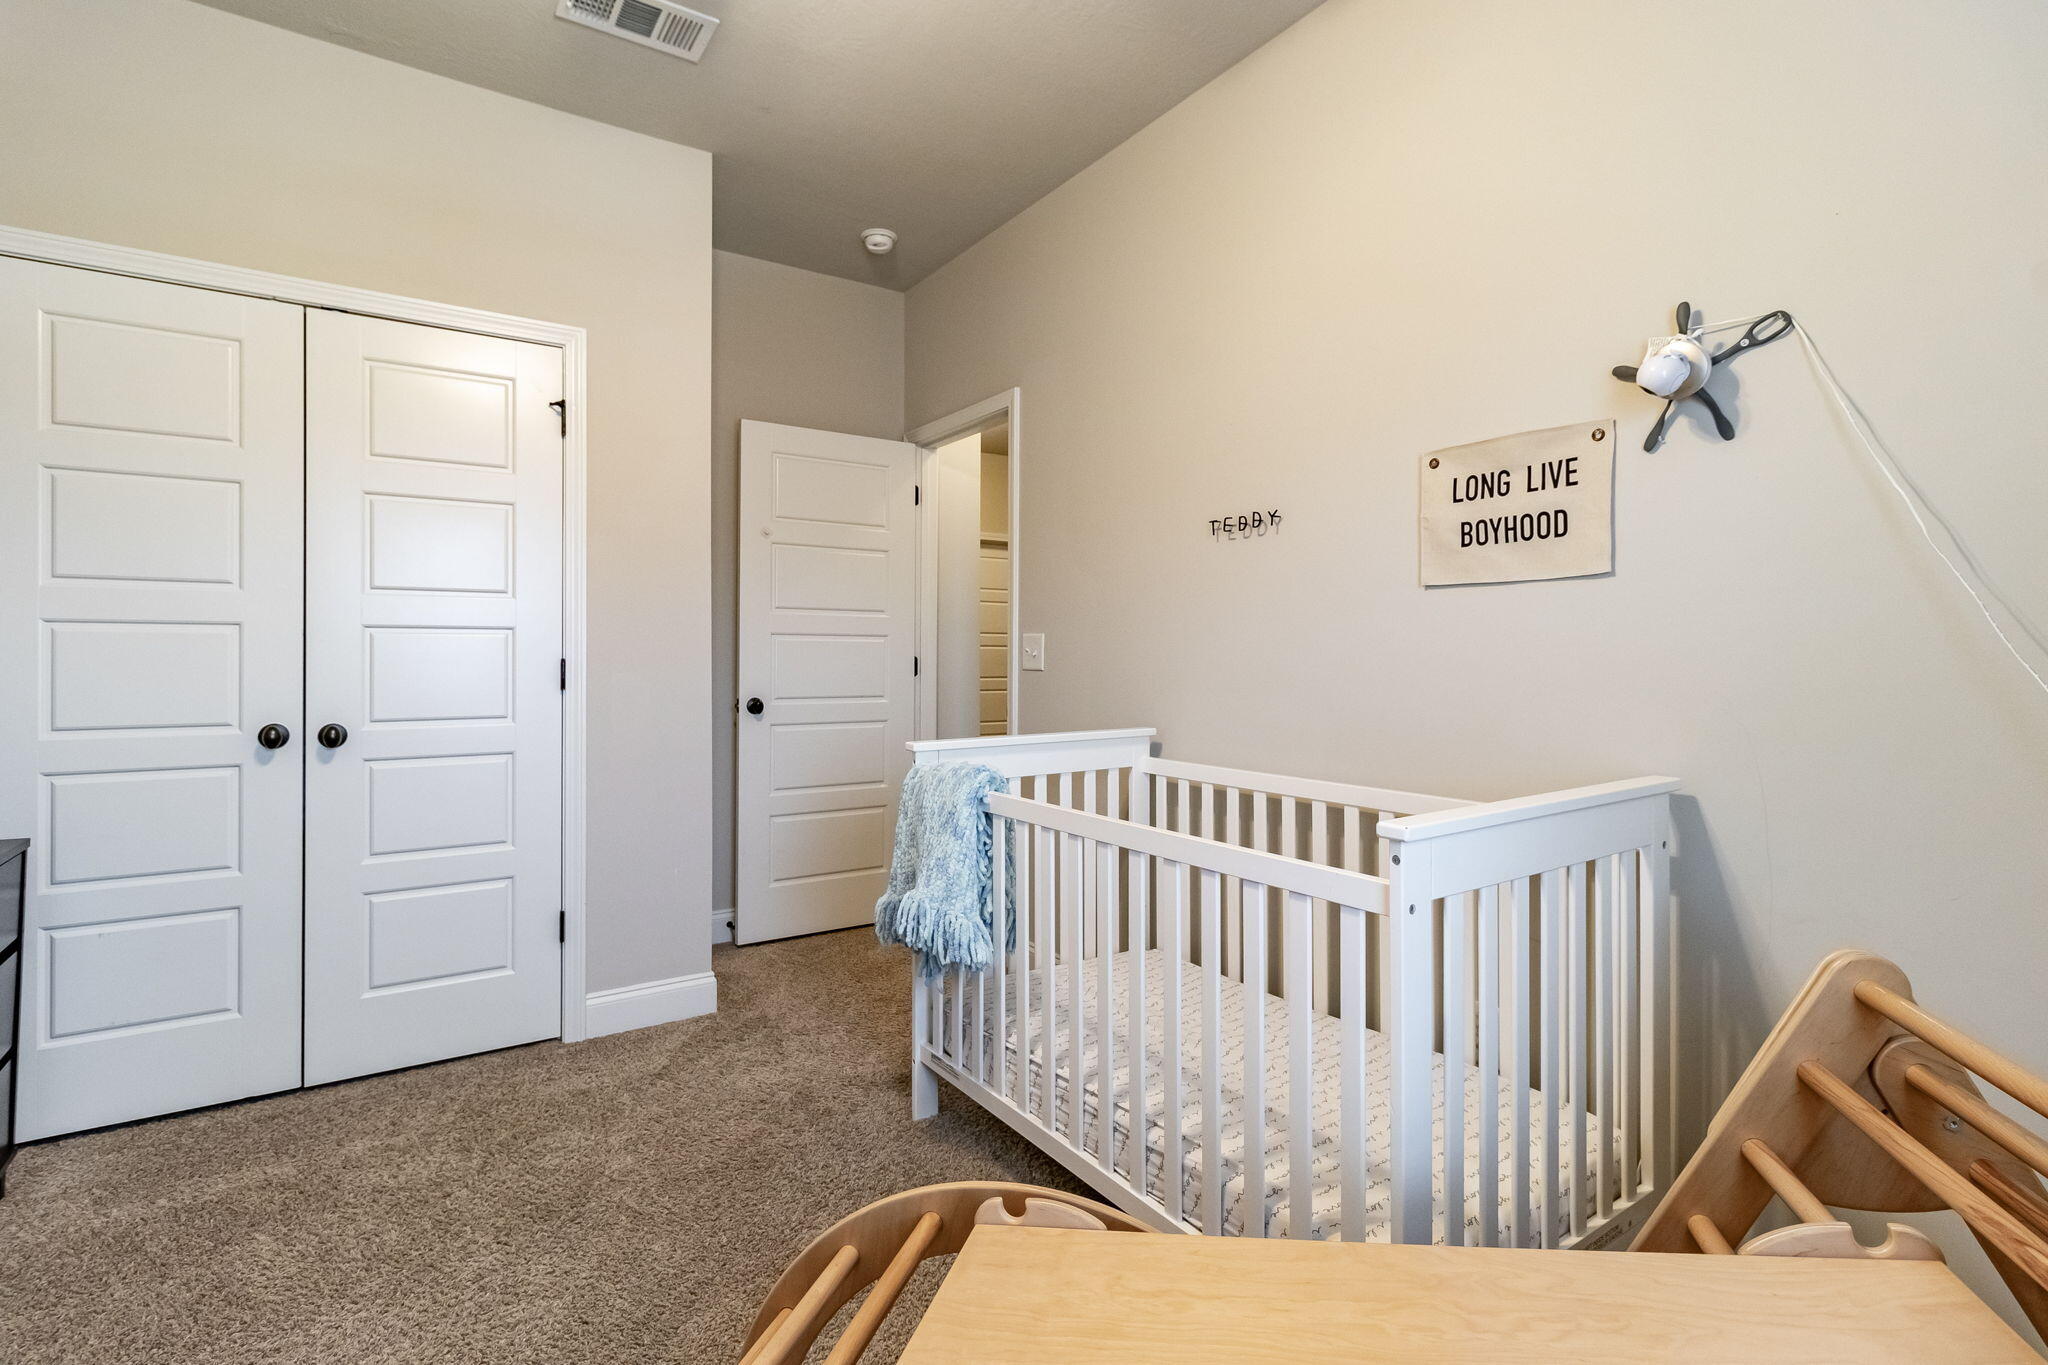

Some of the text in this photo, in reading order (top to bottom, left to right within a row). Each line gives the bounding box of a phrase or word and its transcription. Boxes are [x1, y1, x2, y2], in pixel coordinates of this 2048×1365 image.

[1452, 456, 1579, 504] LONG LIVE
[1208, 508, 1279, 536] TEDDY
[1460, 508, 1569, 548] BOYHOOD
